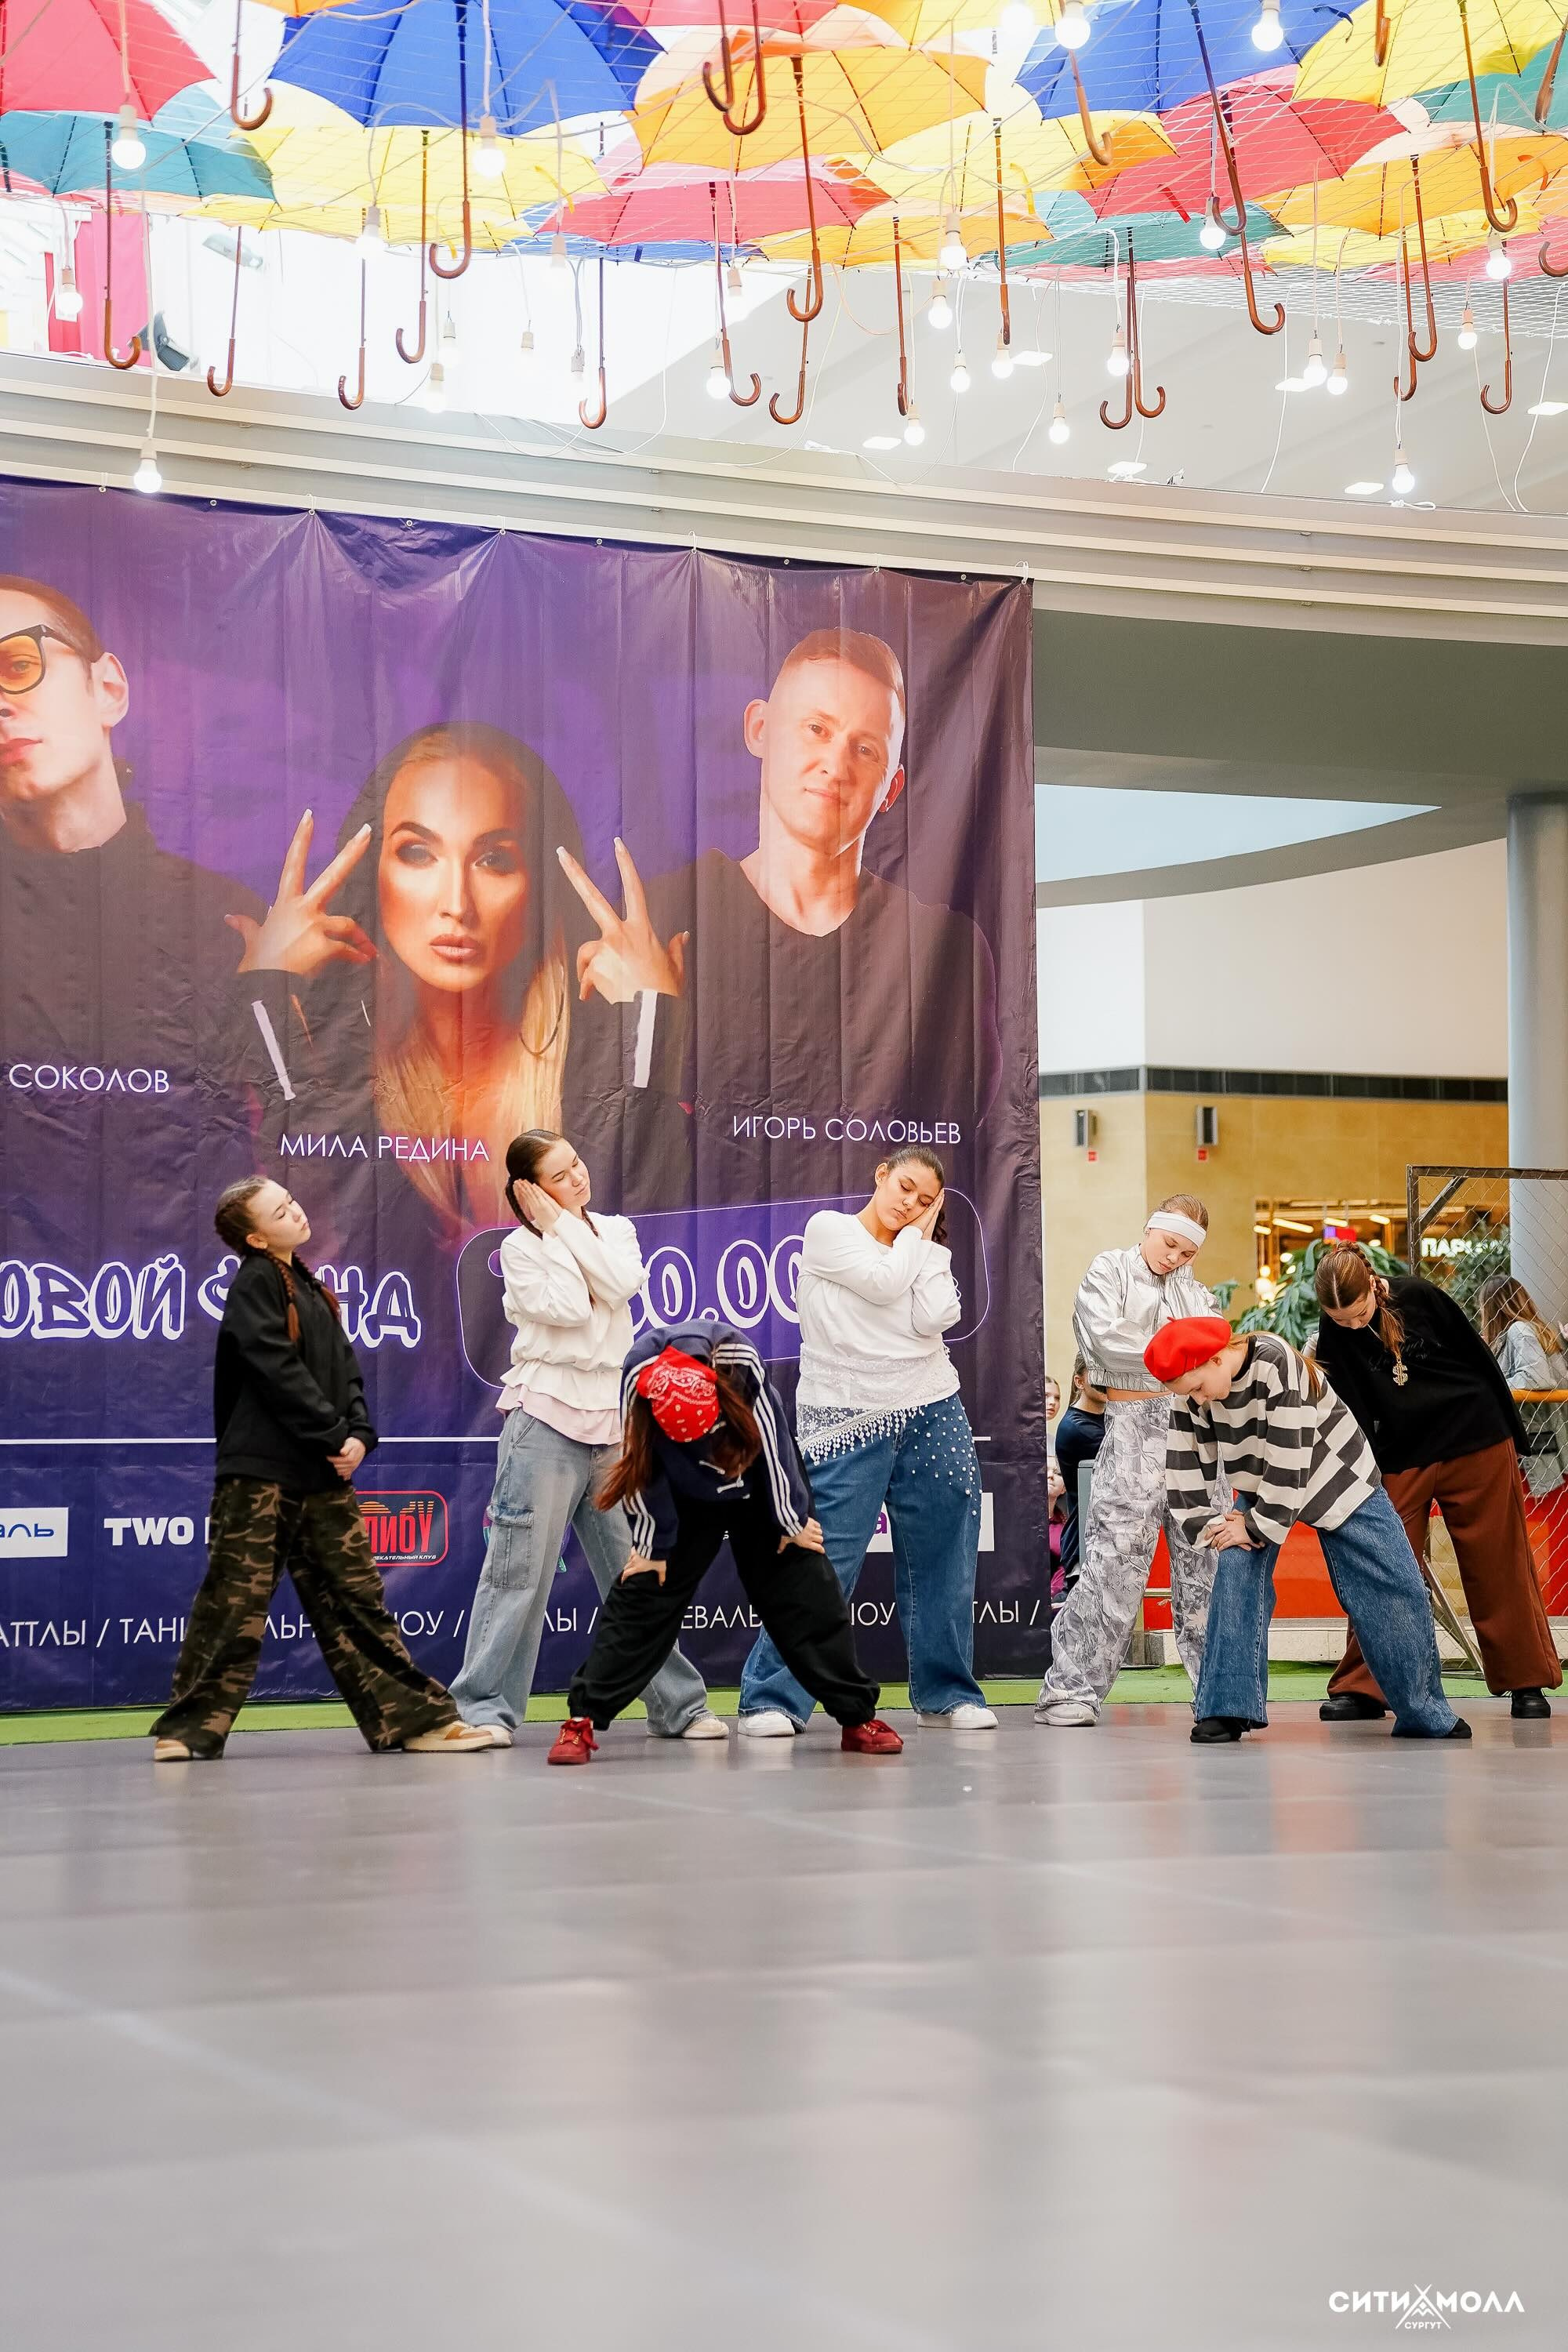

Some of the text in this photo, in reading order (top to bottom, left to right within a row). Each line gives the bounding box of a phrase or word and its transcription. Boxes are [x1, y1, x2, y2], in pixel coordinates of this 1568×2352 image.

[9, 1063, 170, 1094] СОКОЛОВ
[732, 1115, 962, 1145] ИГОРЬ СОЛОВЬЕВ
[280, 1133, 490, 1163] МИЛА РЕДИНА
[103, 1516, 194, 1546] TWO
